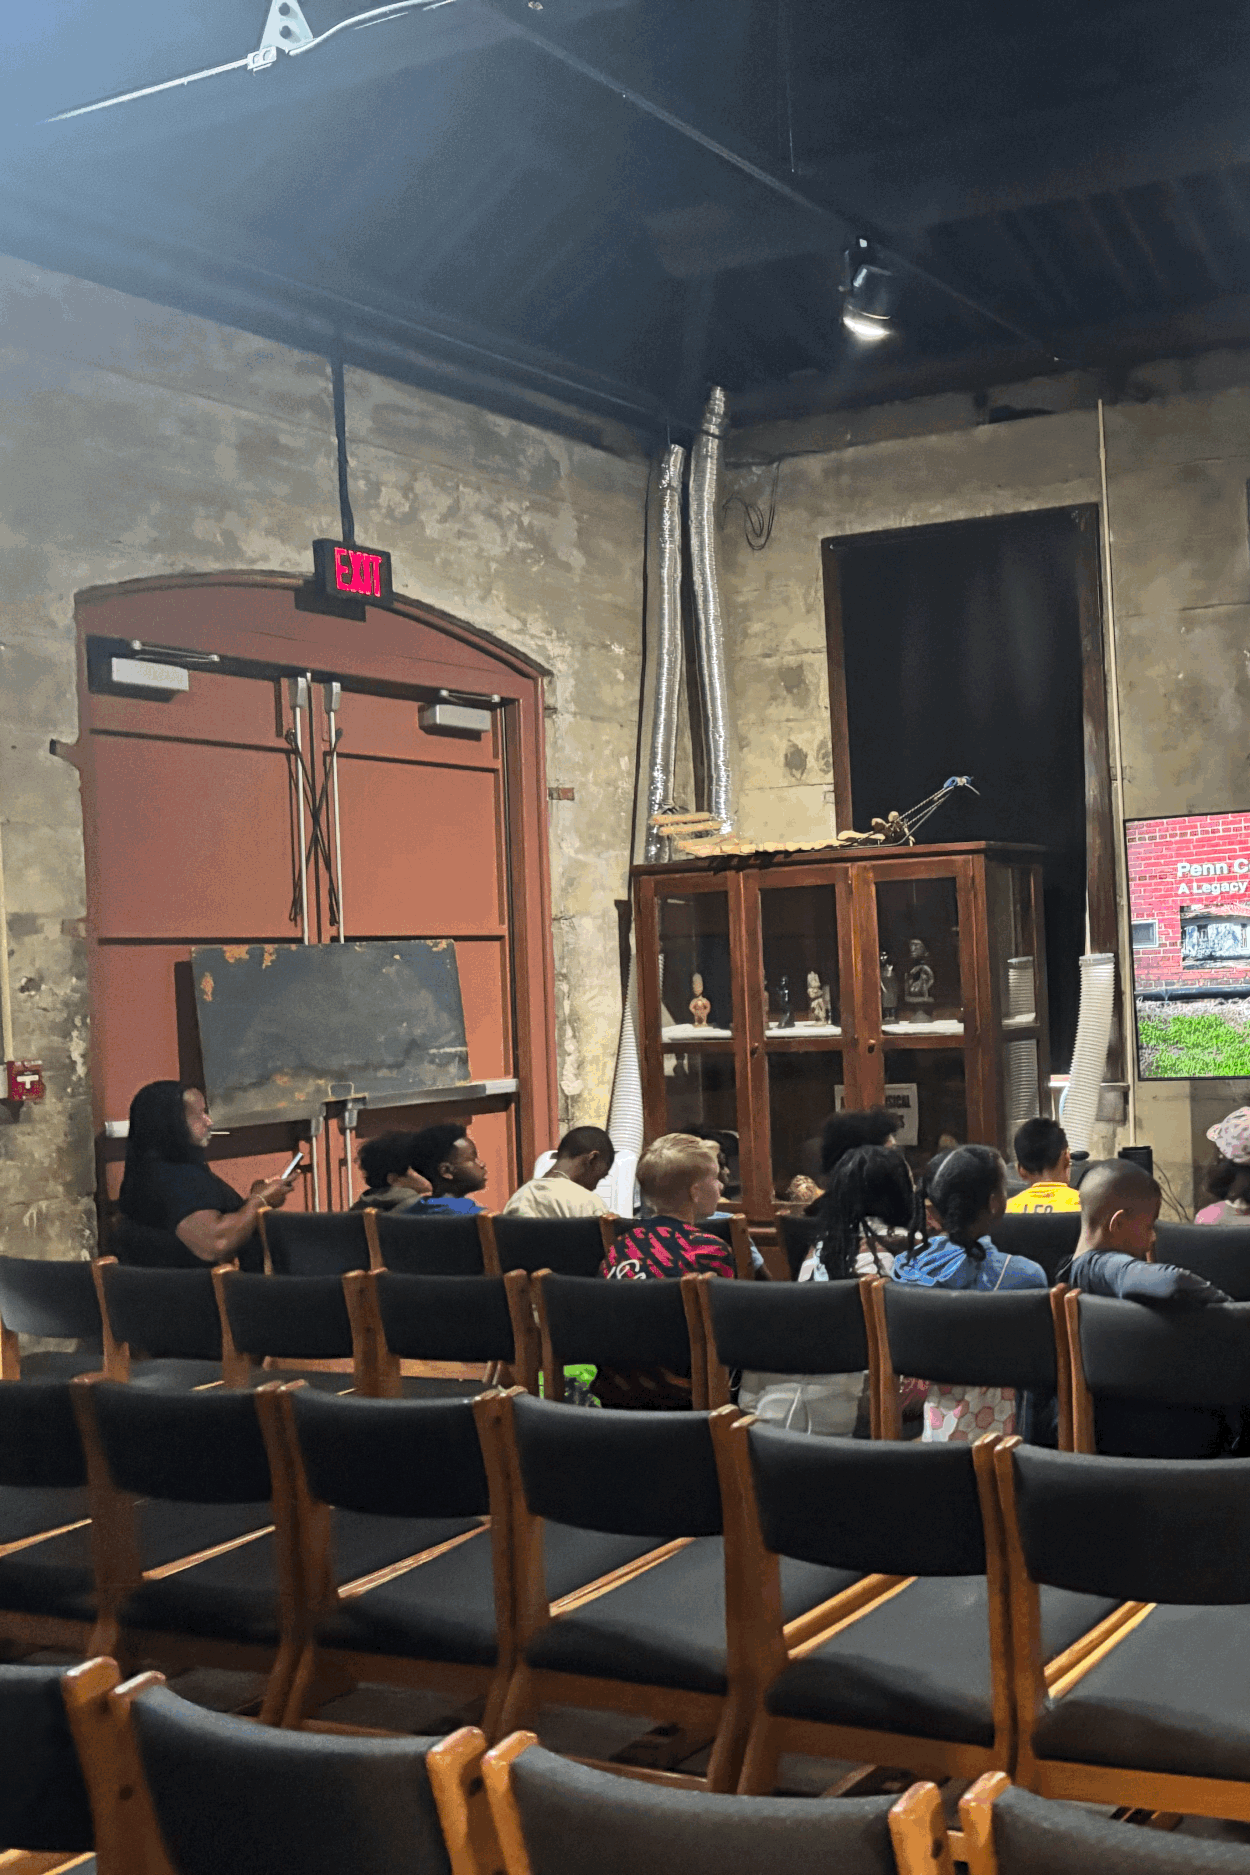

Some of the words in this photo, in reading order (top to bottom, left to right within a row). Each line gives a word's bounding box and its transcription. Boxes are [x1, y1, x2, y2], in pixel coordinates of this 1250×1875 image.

[334, 547, 382, 597] EXIT
[1177, 862, 1228, 878] Penn
[1177, 882, 1190, 895] A
[1193, 879, 1248, 896] Legacy
